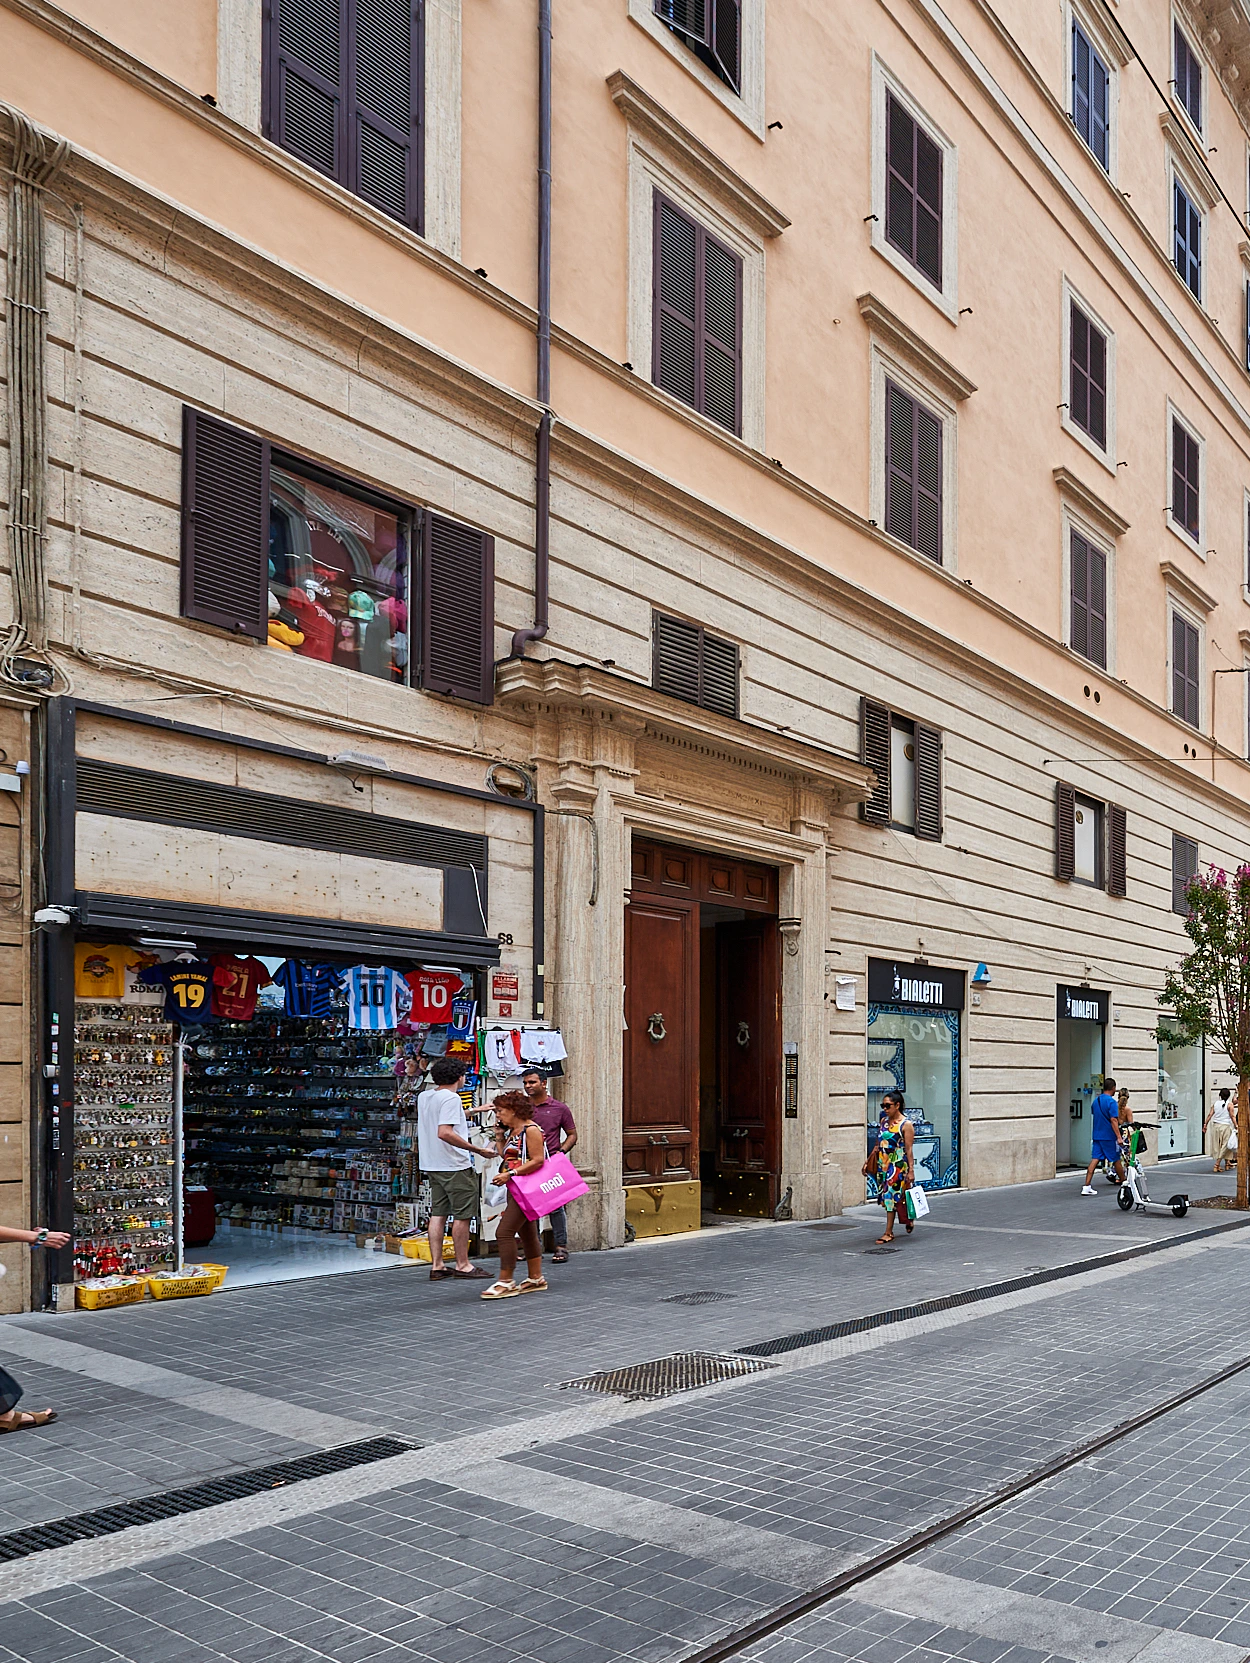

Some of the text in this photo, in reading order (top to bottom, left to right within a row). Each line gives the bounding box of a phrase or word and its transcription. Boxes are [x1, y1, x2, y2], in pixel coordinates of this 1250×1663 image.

[173, 983, 205, 1008] 19
[222, 971, 249, 999] 21
[360, 983, 385, 1007] 10
[421, 984, 447, 1008] 10
